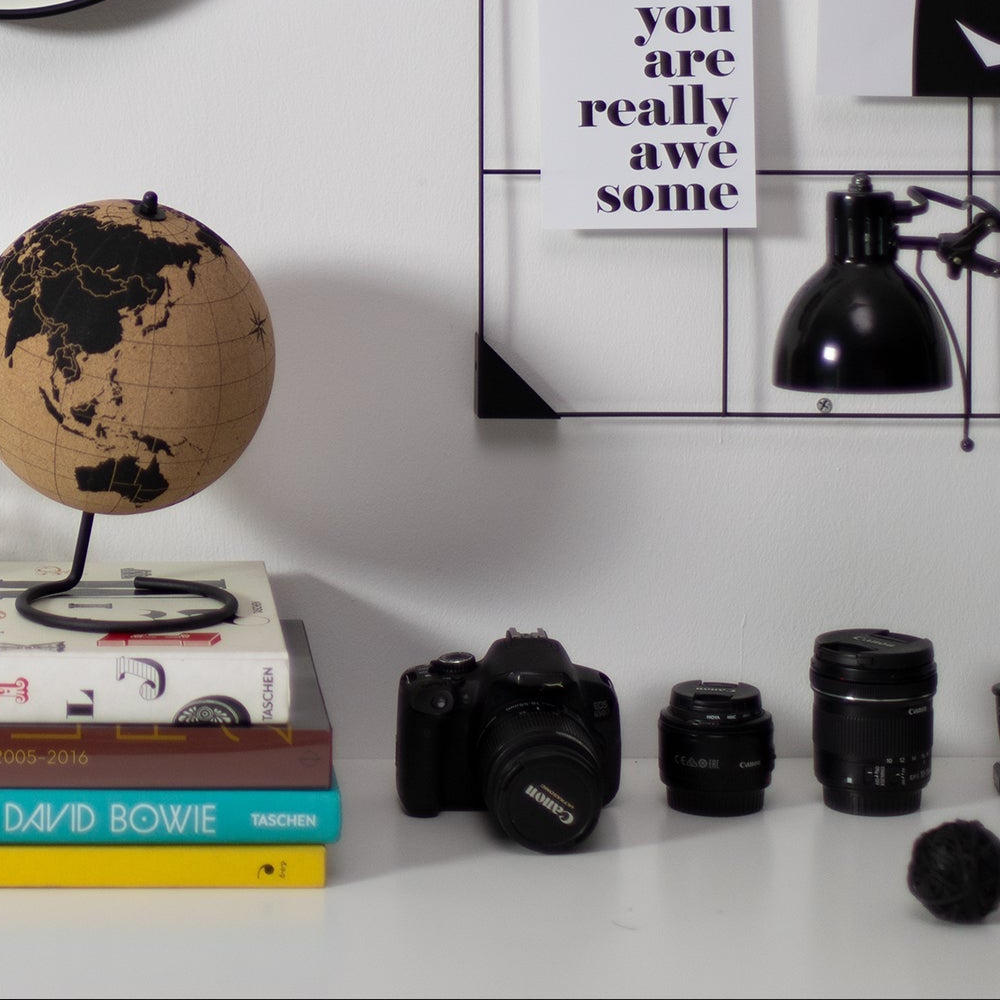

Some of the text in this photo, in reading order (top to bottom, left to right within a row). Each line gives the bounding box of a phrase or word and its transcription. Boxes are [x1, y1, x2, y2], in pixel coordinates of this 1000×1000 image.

[633, 3, 735, 46] you
[643, 46, 735, 79] are
[576, 83, 738, 137] really
[629, 139, 738, 170] awe
[596, 182, 739, 214] some
[262, 666, 274, 721] TASCHEN
[739, 760, 761, 769] Canon
[5, 803, 96, 833] DAVID
[111, 803, 217, 834] BOWIE
[251, 813, 317, 828] TASCHEN
[525, 784, 574, 825] Canon
